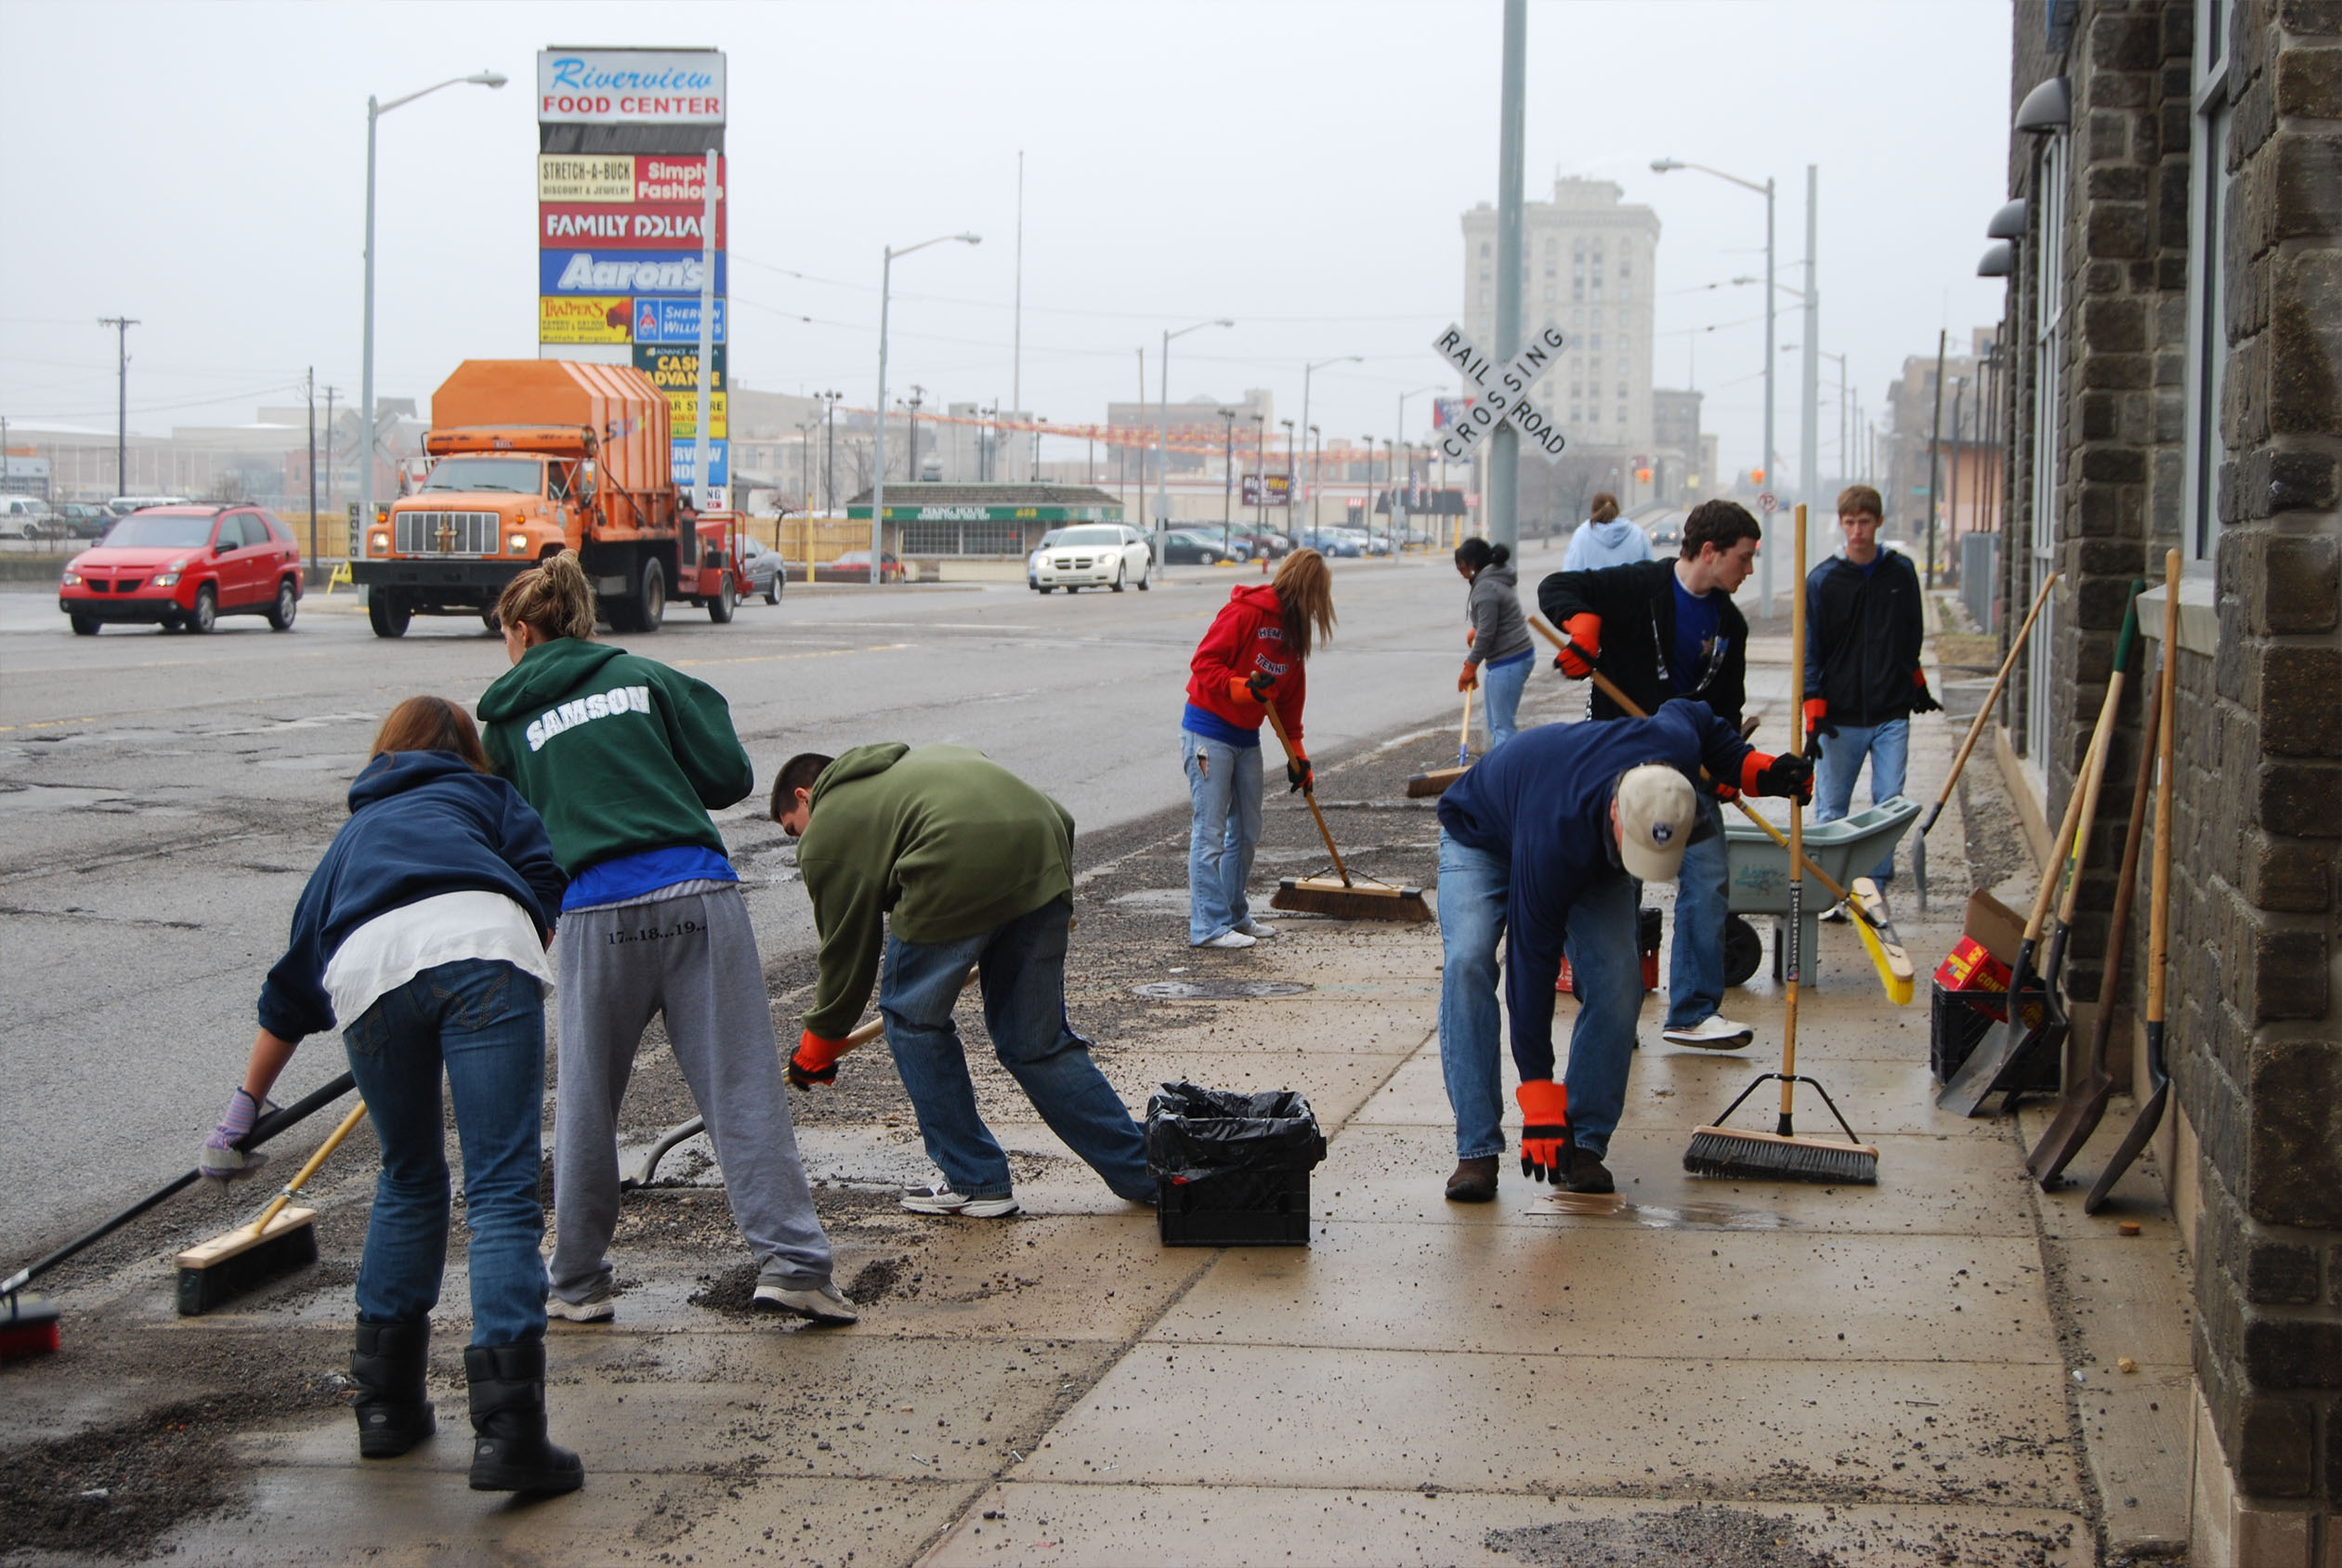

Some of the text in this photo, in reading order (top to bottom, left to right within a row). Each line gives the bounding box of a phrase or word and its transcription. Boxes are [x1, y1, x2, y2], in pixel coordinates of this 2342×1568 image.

[551, 57, 713, 90] Riverview
[543, 95, 721, 114] FOOD CENTER
[543, 162, 631, 180] STRETCH-A-BUCK
[543, 186, 583, 195] DISCOUNT
[594, 186, 631, 195] JEWELRY
[546, 214, 630, 237] FAMILY
[557, 253, 705, 291] Aaron's
[665, 306, 721, 320] SHERN
[663, 320, 722, 334] WILLIS
[644, 371, 721, 387] ADVANE
[1440, 330, 1565, 454] RAIL ROAD
[1443, 329, 1564, 457] CROSSING
[526, 686, 650, 752] SAMSON
